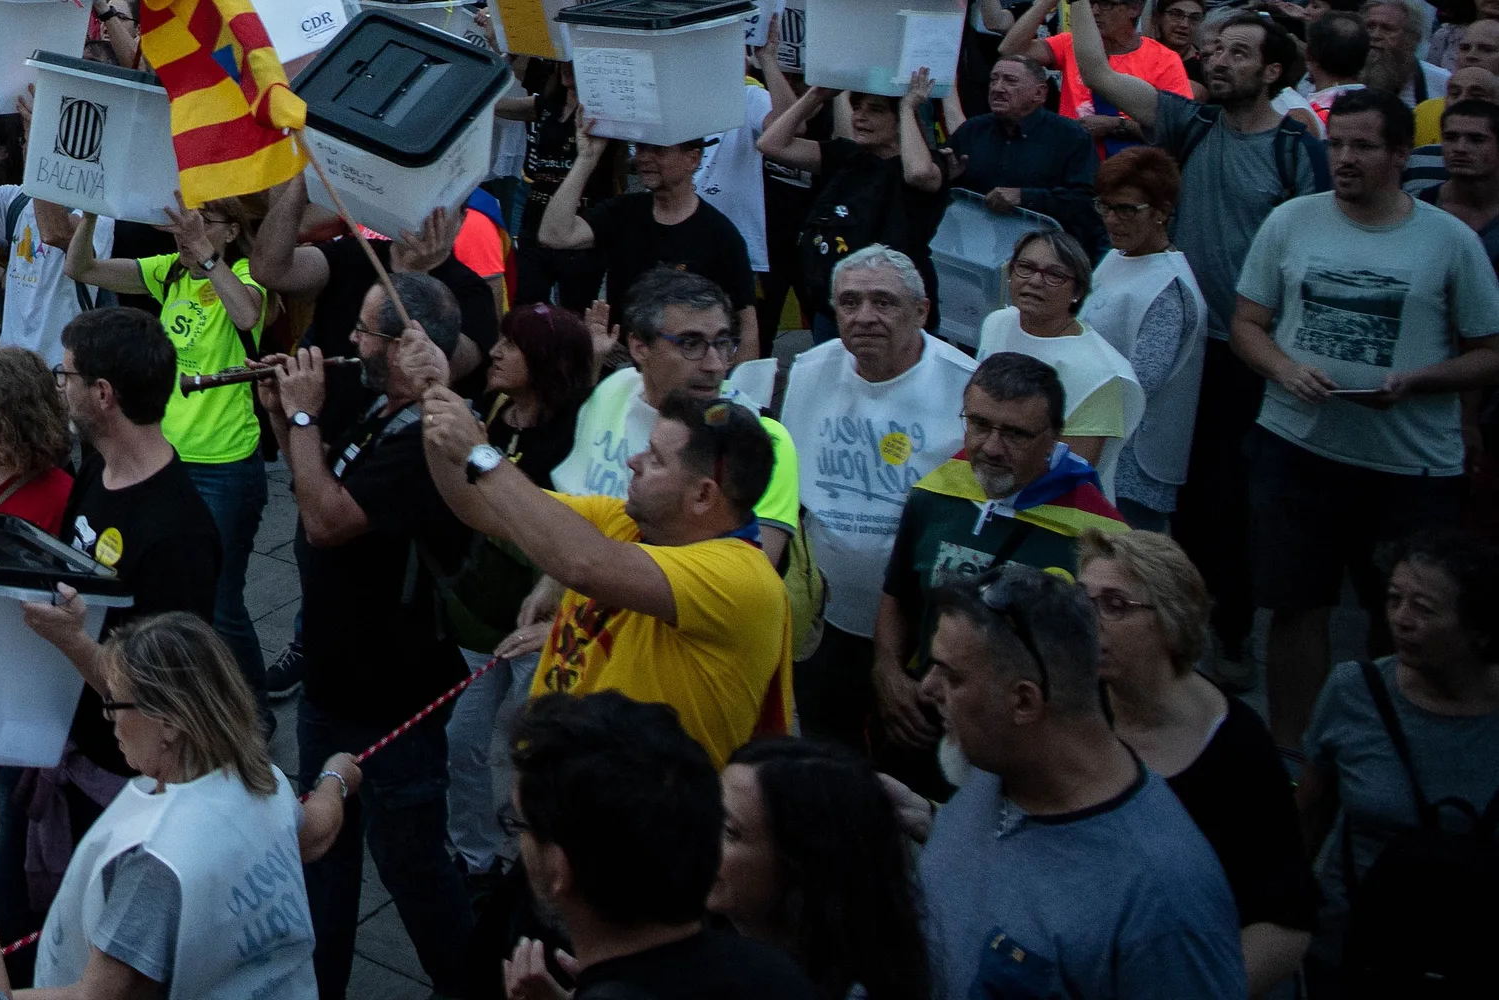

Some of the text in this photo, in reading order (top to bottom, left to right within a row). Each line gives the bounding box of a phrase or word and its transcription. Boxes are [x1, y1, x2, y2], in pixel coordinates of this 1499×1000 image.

[301, 11, 333, 32] CDR
[37, 157, 105, 200] BALENYÀ
[341, 164, 375, 182] OBLIT
